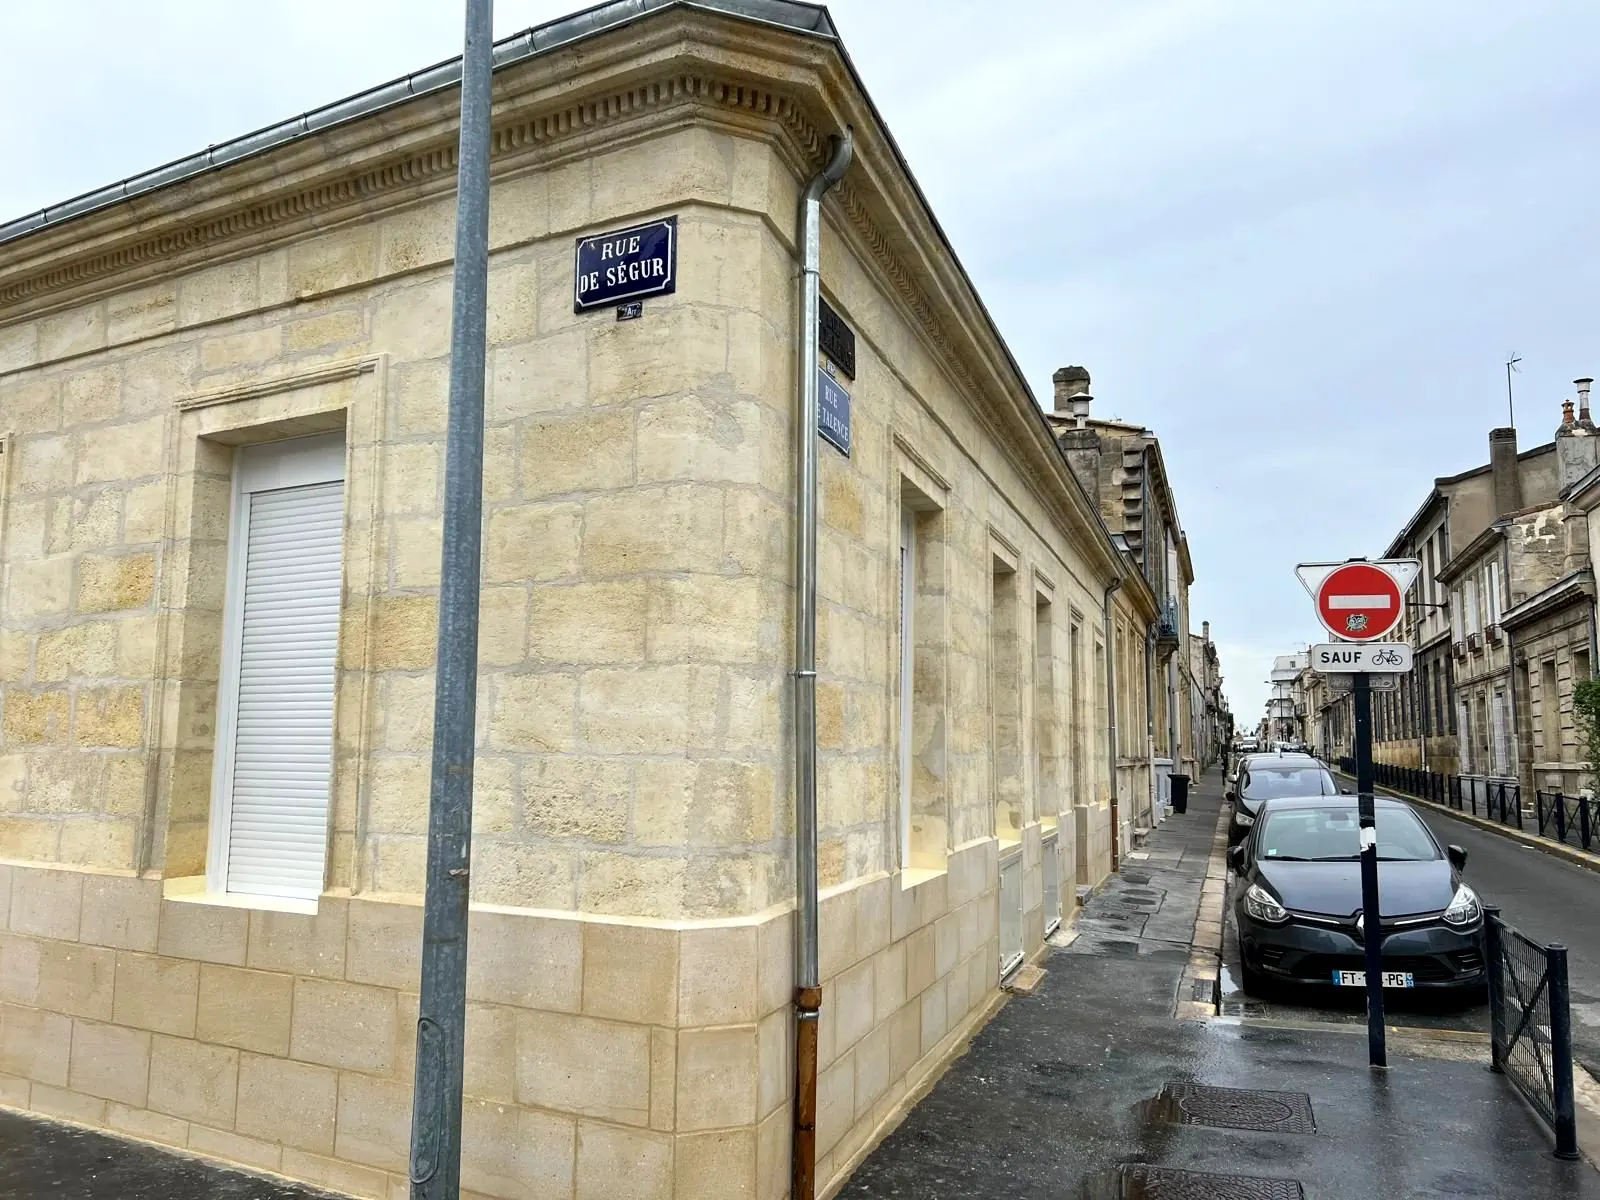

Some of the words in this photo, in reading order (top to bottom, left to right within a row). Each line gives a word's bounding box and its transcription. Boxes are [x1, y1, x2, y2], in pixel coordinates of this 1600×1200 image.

[601, 236, 641, 260] RUE
[580, 271, 599, 294] DE
[606, 258, 664, 287] SÉGUR
[825, 385, 838, 408] RUE
[822, 407, 849, 442] TALENCE
[1321, 652, 1362, 664] SAUF
[1341, 972, 1404, 986] FT--PG
